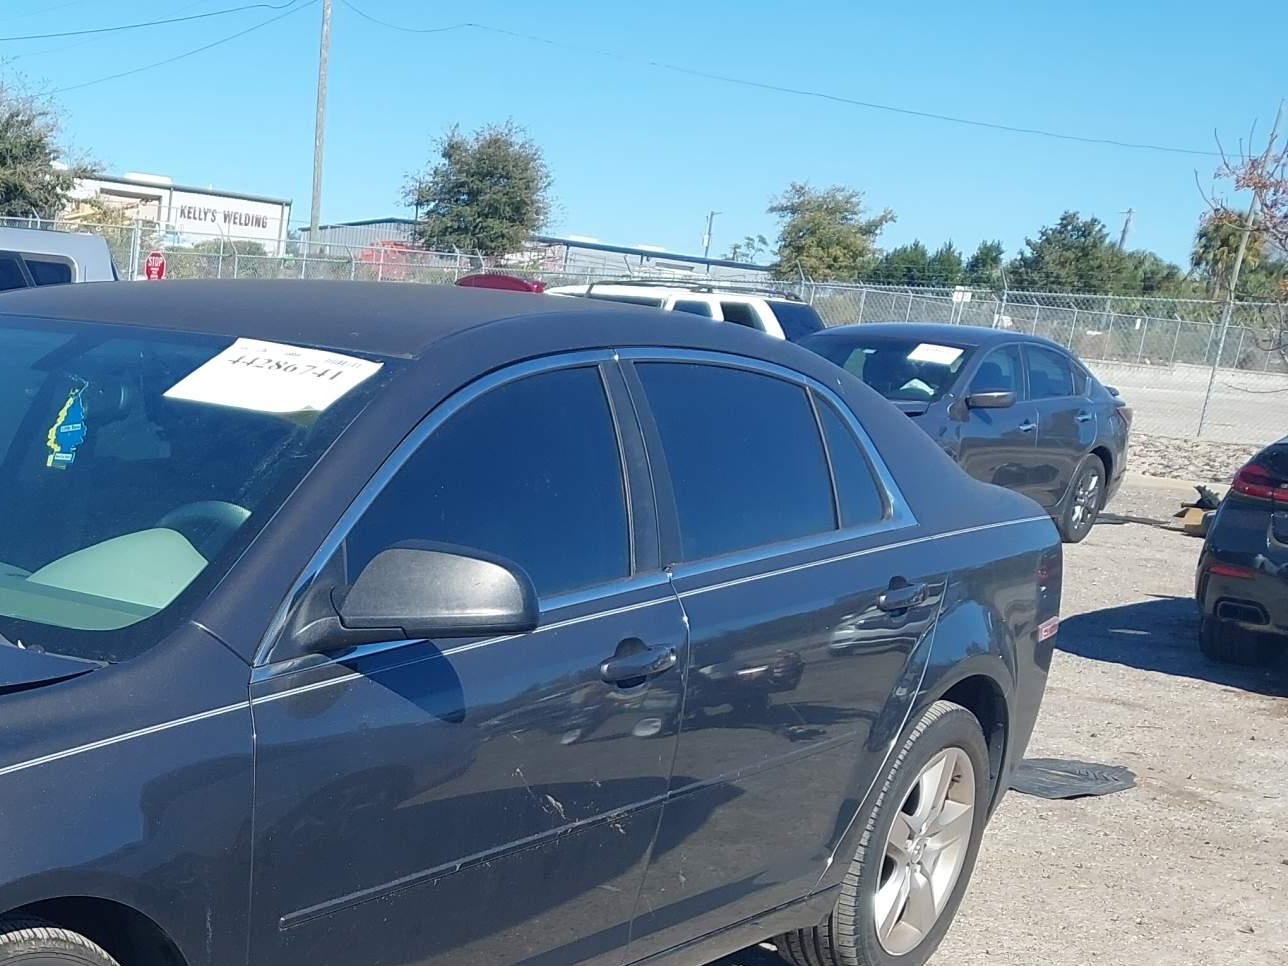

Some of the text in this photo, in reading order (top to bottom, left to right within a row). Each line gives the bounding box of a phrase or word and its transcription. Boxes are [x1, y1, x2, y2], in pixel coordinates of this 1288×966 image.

[180, 205, 268, 229] KELLY'S WELDING
[147, 255, 163, 267] STOP
[227, 355, 343, 381] 44286741
